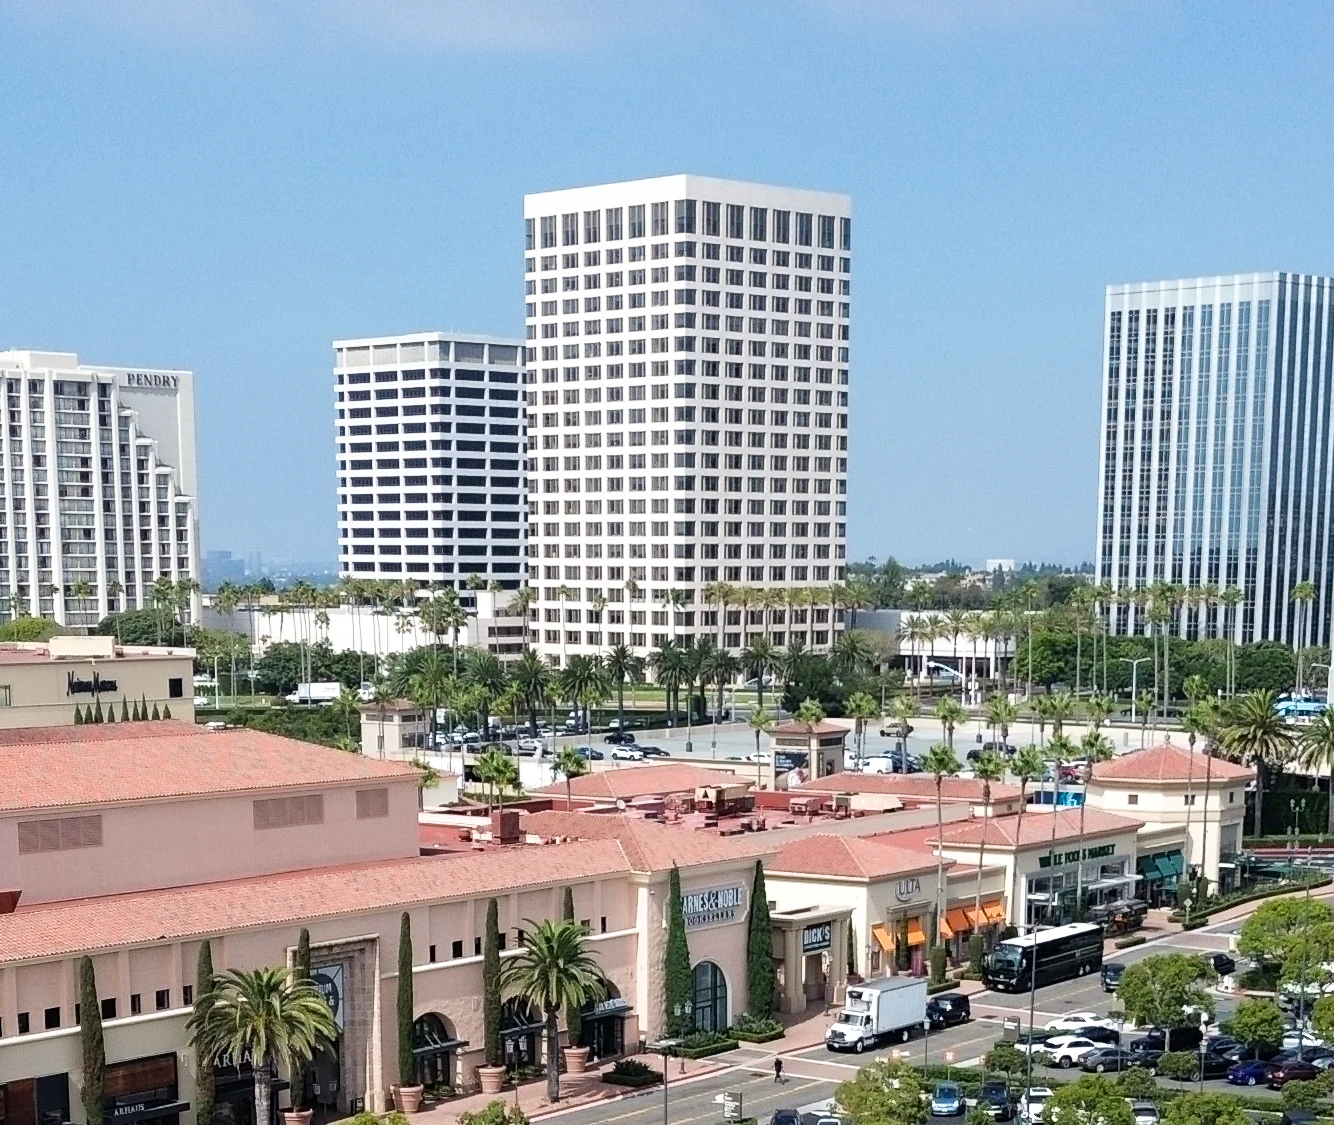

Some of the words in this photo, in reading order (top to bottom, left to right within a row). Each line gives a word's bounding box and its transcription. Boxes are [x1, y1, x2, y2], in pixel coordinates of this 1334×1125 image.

[127, 372, 179, 387] PENDRY
[1039, 853, 1063, 868] WHLE
[1064, 849, 1087, 864] FOOS
[895, 878, 920, 900] ULTA
[804, 925, 830, 945] DICK'S
